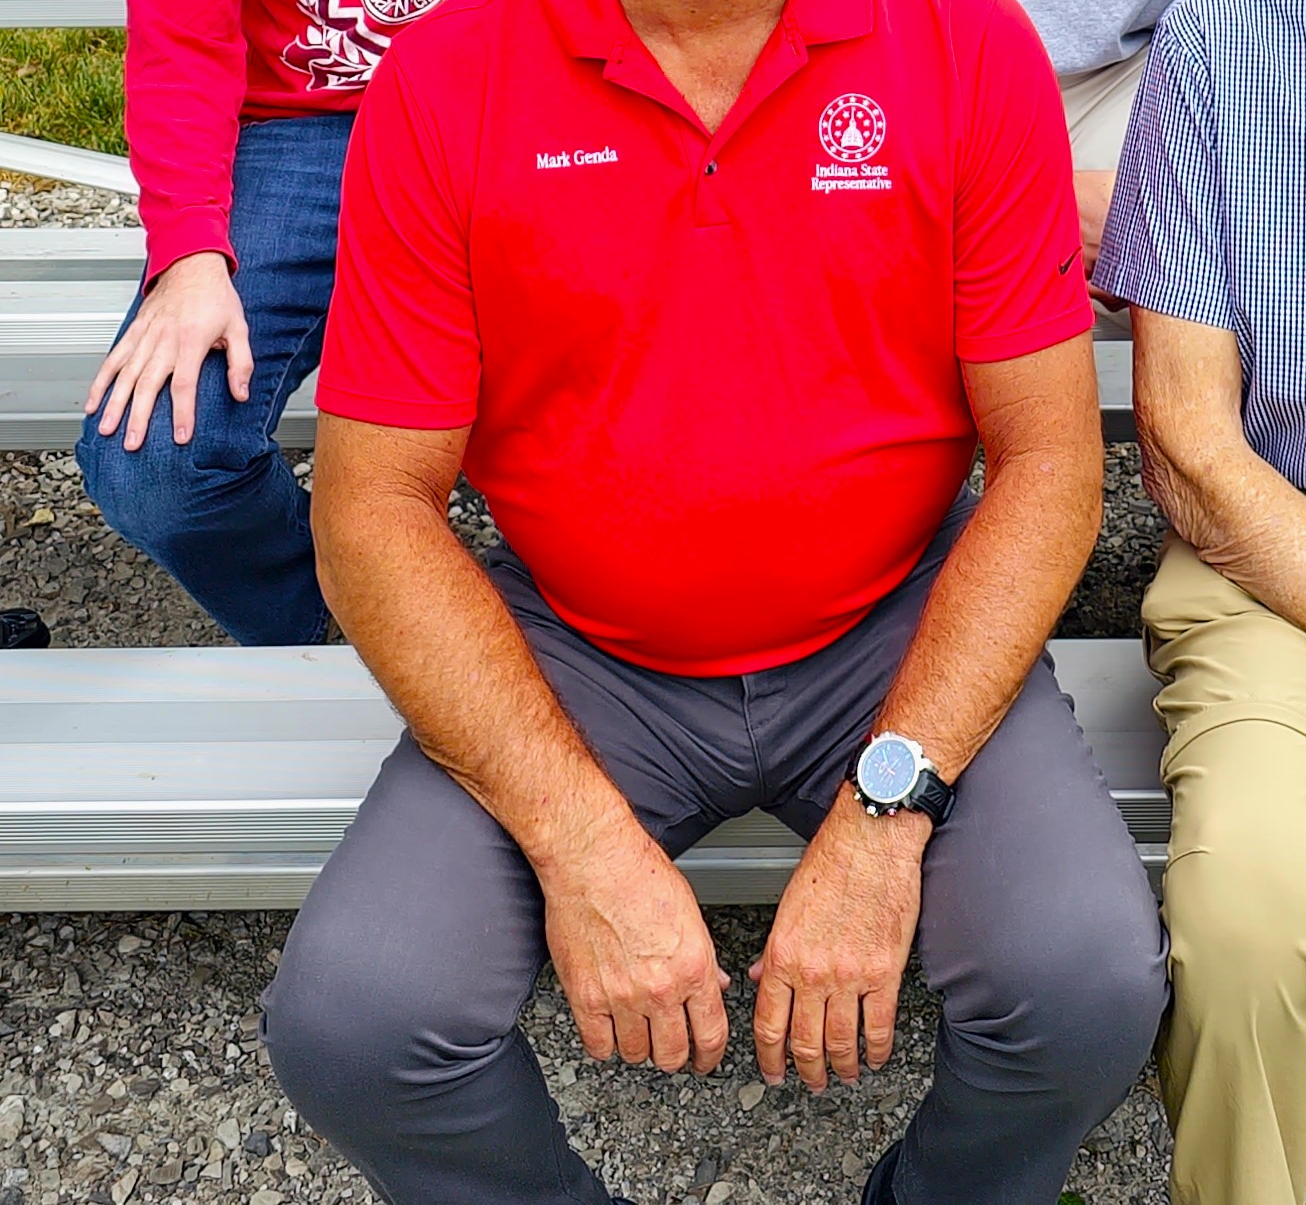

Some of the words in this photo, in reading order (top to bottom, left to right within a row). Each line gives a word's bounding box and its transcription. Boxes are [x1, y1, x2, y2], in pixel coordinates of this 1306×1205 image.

[536, 151, 570, 169] Mark
[573, 146, 618, 165] Genda
[815, 163, 859, 177] Indiana
[860, 163, 888, 176] State
[811, 177, 892, 194] Representative
